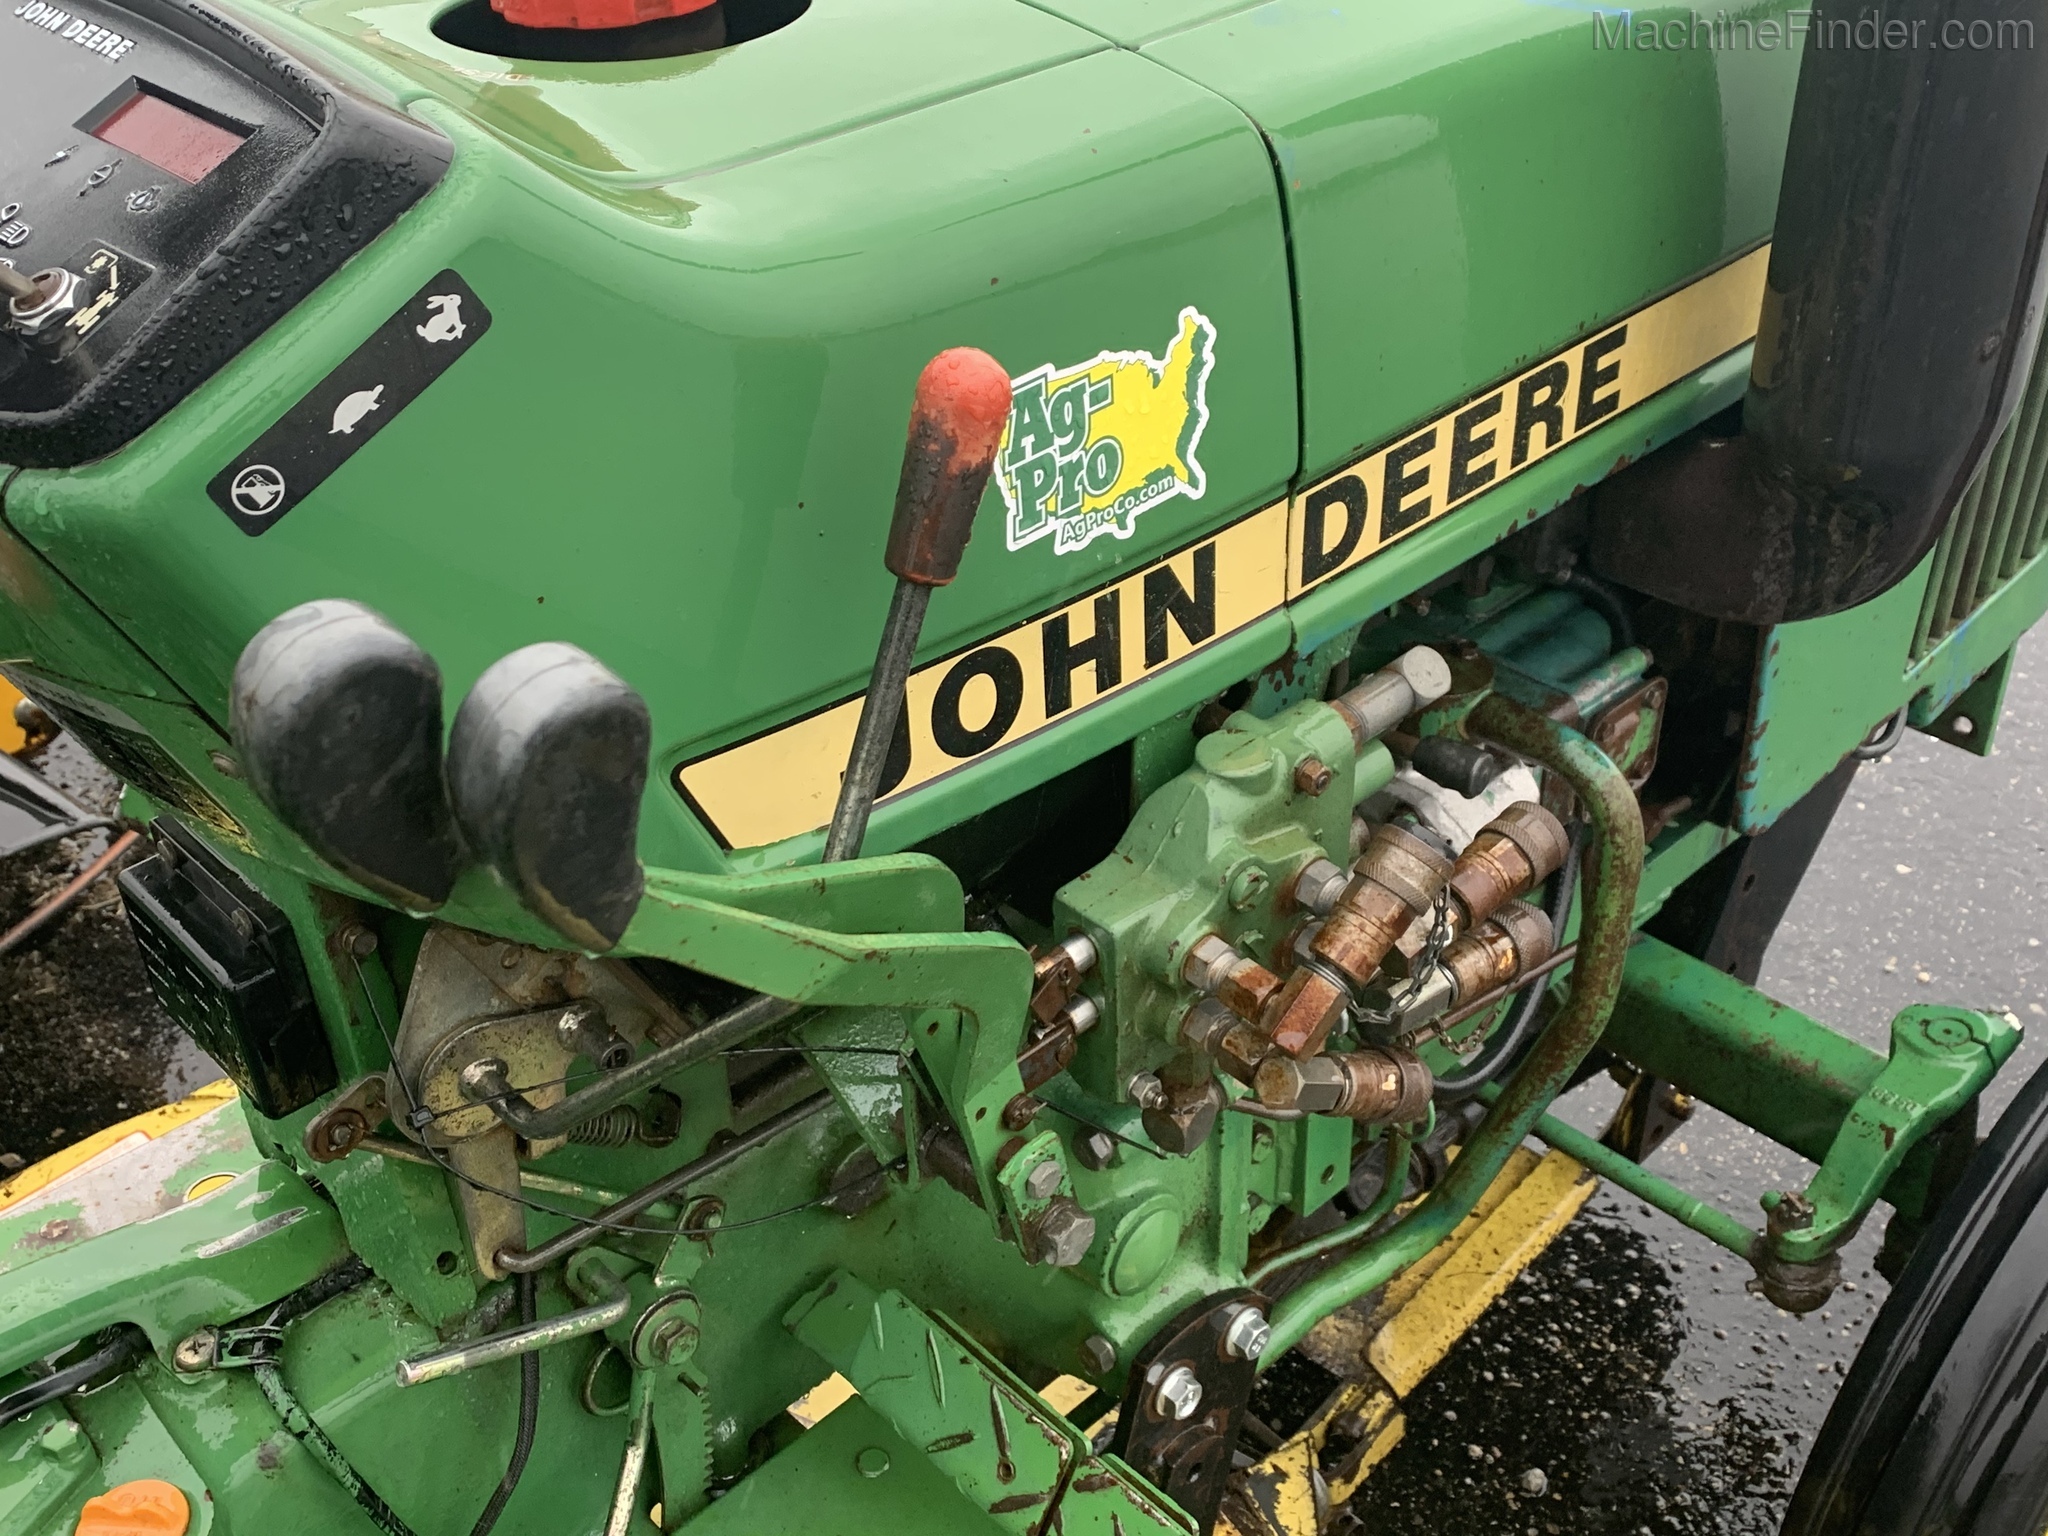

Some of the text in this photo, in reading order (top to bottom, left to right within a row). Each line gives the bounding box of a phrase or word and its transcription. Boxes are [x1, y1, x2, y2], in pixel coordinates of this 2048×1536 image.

[14, 0, 136, 61] JOHN DEERE
[1006, 374, 1114, 468] Ag-
[1301, 323, 1628, 588] DEERE
[1012, 436, 1123, 540] Pro
[1061, 473, 1175, 546] AgProCo.com
